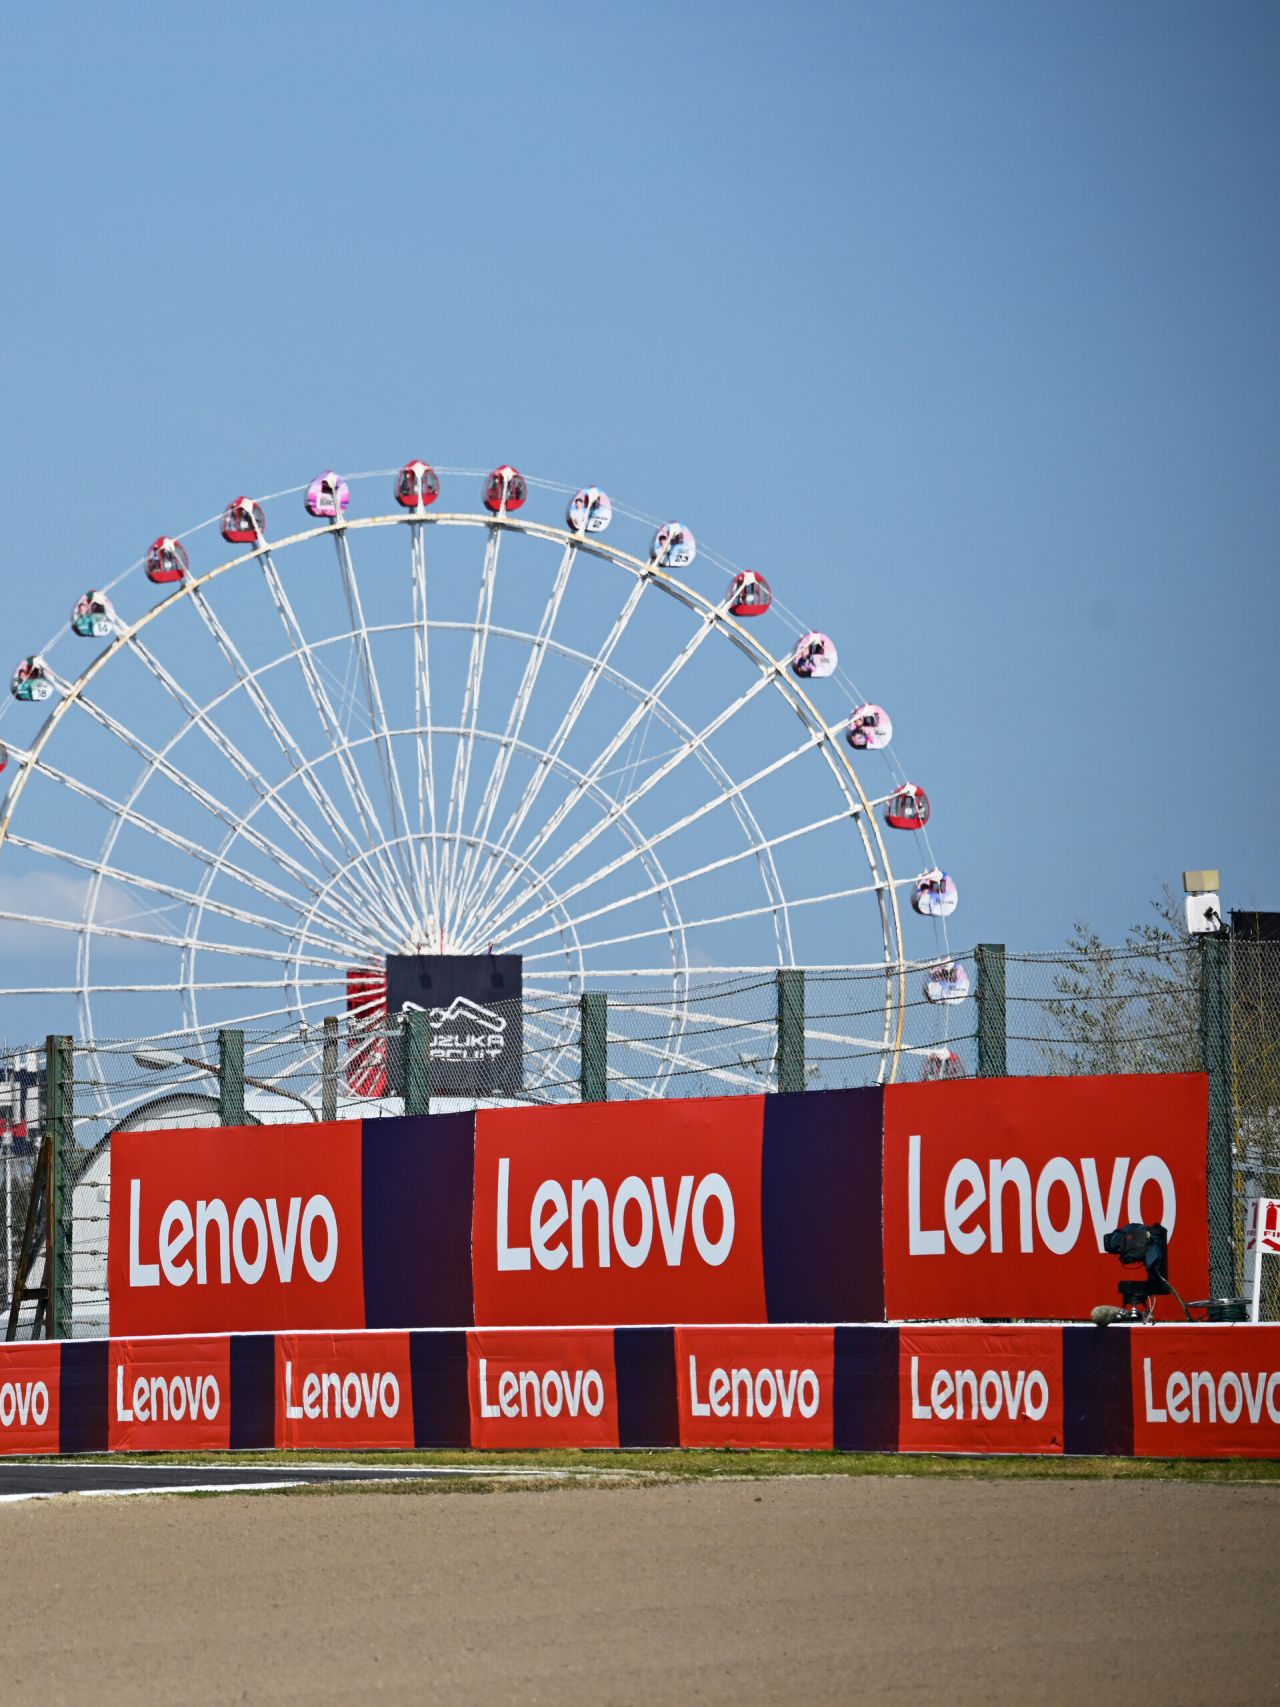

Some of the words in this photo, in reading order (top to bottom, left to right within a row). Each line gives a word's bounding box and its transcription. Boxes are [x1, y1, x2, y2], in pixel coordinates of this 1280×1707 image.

[429, 1034, 504, 1047] ZUKA
[497, 1158, 735, 1271] Lenovo
[908, 1135, 1176, 1255] Lenovo
[130, 1179, 338, 1287] Lenovo
[117, 1366, 220, 1422] Lenovo
[285, 1361, 400, 1419] Lenovo
[480, 1359, 604, 1418] Lenovo
[690, 1355, 819, 1418] Lenovo
[911, 1356, 1048, 1420] Lenovo
